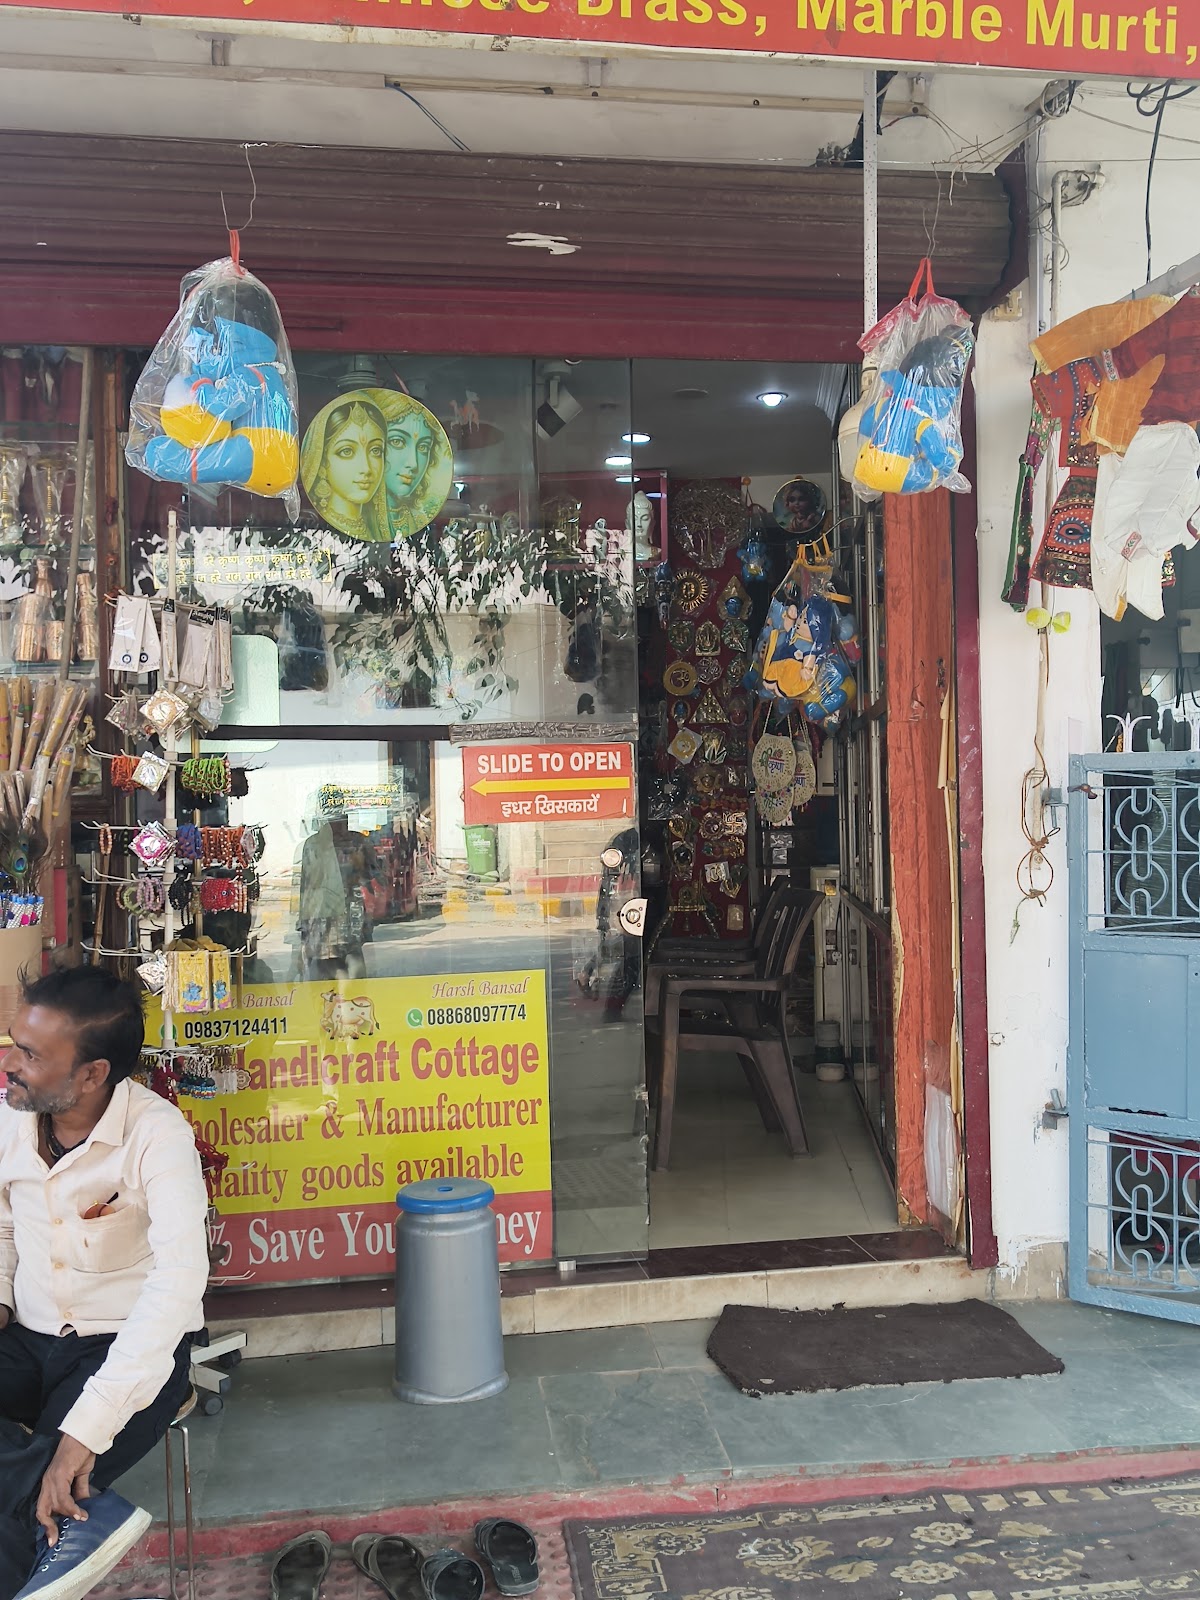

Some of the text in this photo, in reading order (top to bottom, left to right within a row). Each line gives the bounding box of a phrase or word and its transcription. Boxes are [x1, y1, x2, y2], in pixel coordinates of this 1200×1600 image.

[797, 0, 1002, 42] Marble
[1026, 0, 1198, 66] Murti,
[477, 751, 621, 774] SLIDE TO OPEN
[501, 793, 600, 818] इधर खिसकायें
[243, 989, 297, 1008] Bansal
[432, 977, 530, 998] Harsh Bansal
[427, 1004, 526, 1025] 08868097774
[184, 1017, 287, 1039] 09837124411
[411, 1036, 539, 1085] Cottage
[182, 1092, 542, 1147] holesaler & Manufacturer
[302, 1153, 384, 1201] goods
[397, 1143, 523, 1185] available
[249, 1218, 325, 1265] Save
